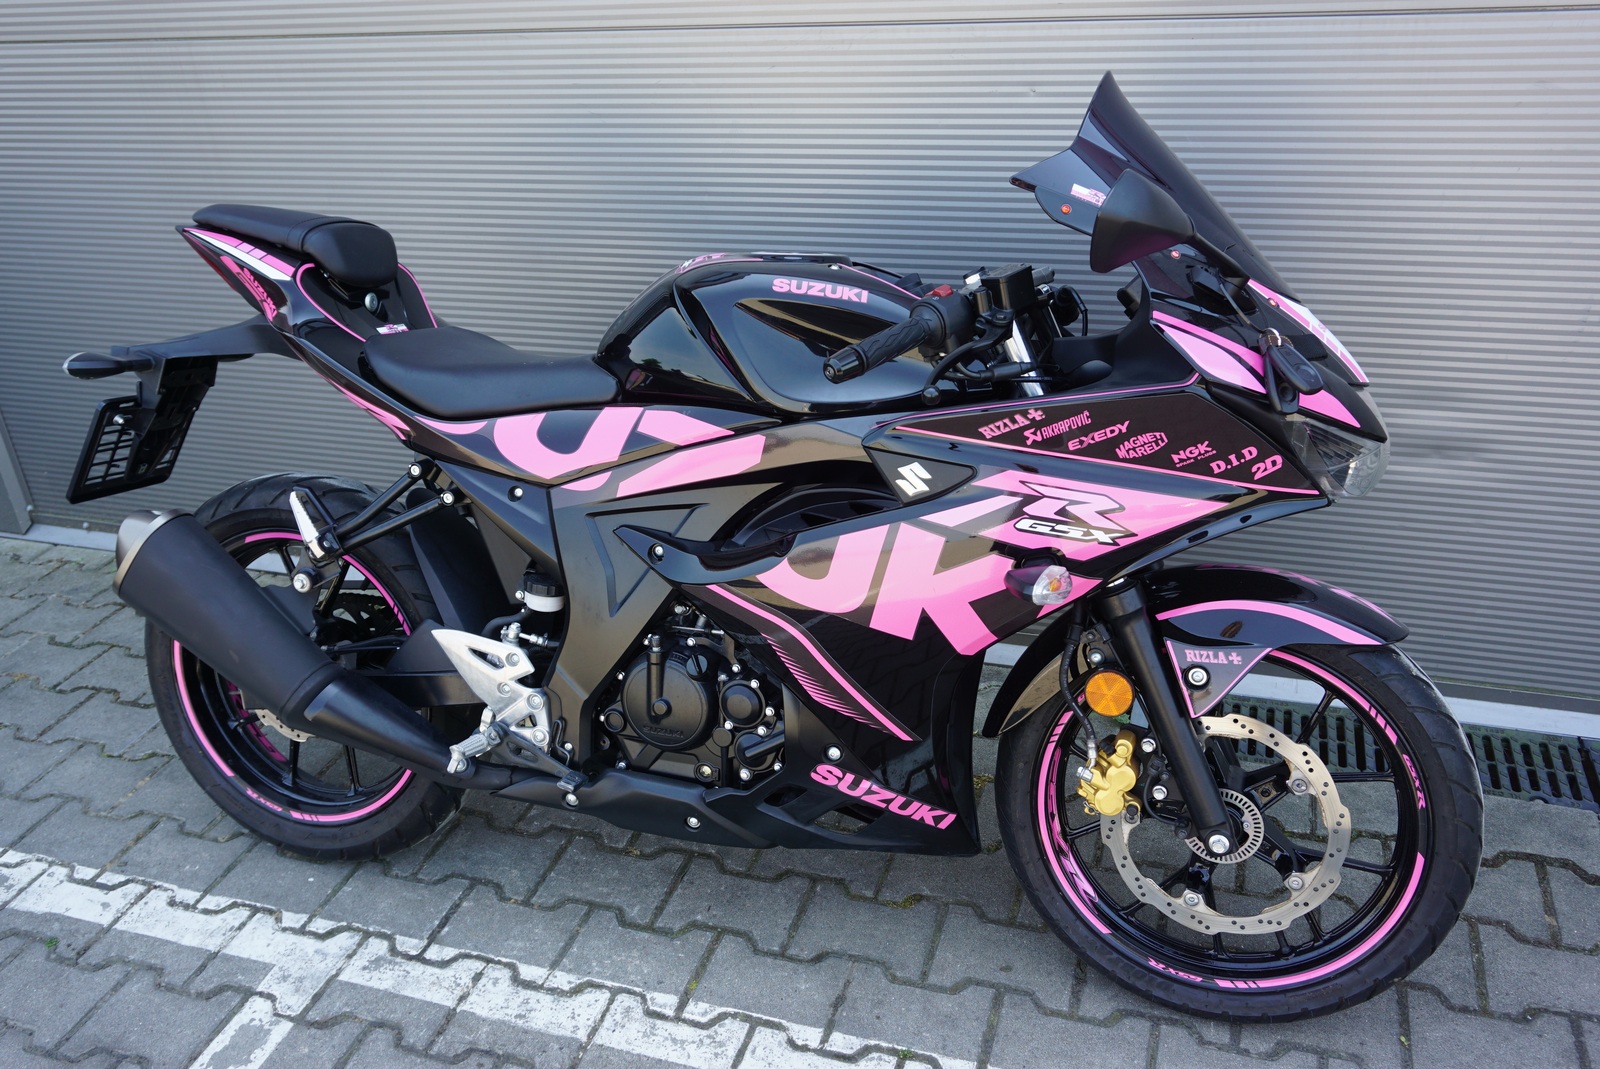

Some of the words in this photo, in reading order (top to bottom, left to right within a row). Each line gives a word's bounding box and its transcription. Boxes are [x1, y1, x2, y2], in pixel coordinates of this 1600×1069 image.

[772, 278, 869, 303] SUZUKI
[1041, 410, 1092, 440] AKRAPOVIČ
[1067, 420, 1130, 451] EXEDY
[1115, 432, 1168, 456] MAGNETI
[1116, 439, 1168, 459] MARELLI
[1170, 440, 1212, 464] NGK
[1175, 458, 1195, 468] SPARK
[1197, 450, 1217, 460] PLUGS
[1209, 446, 1258, 475] D.I.D
[1251, 454, 1283, 481] 2D
[810, 763, 957, 830] SUZUKI
